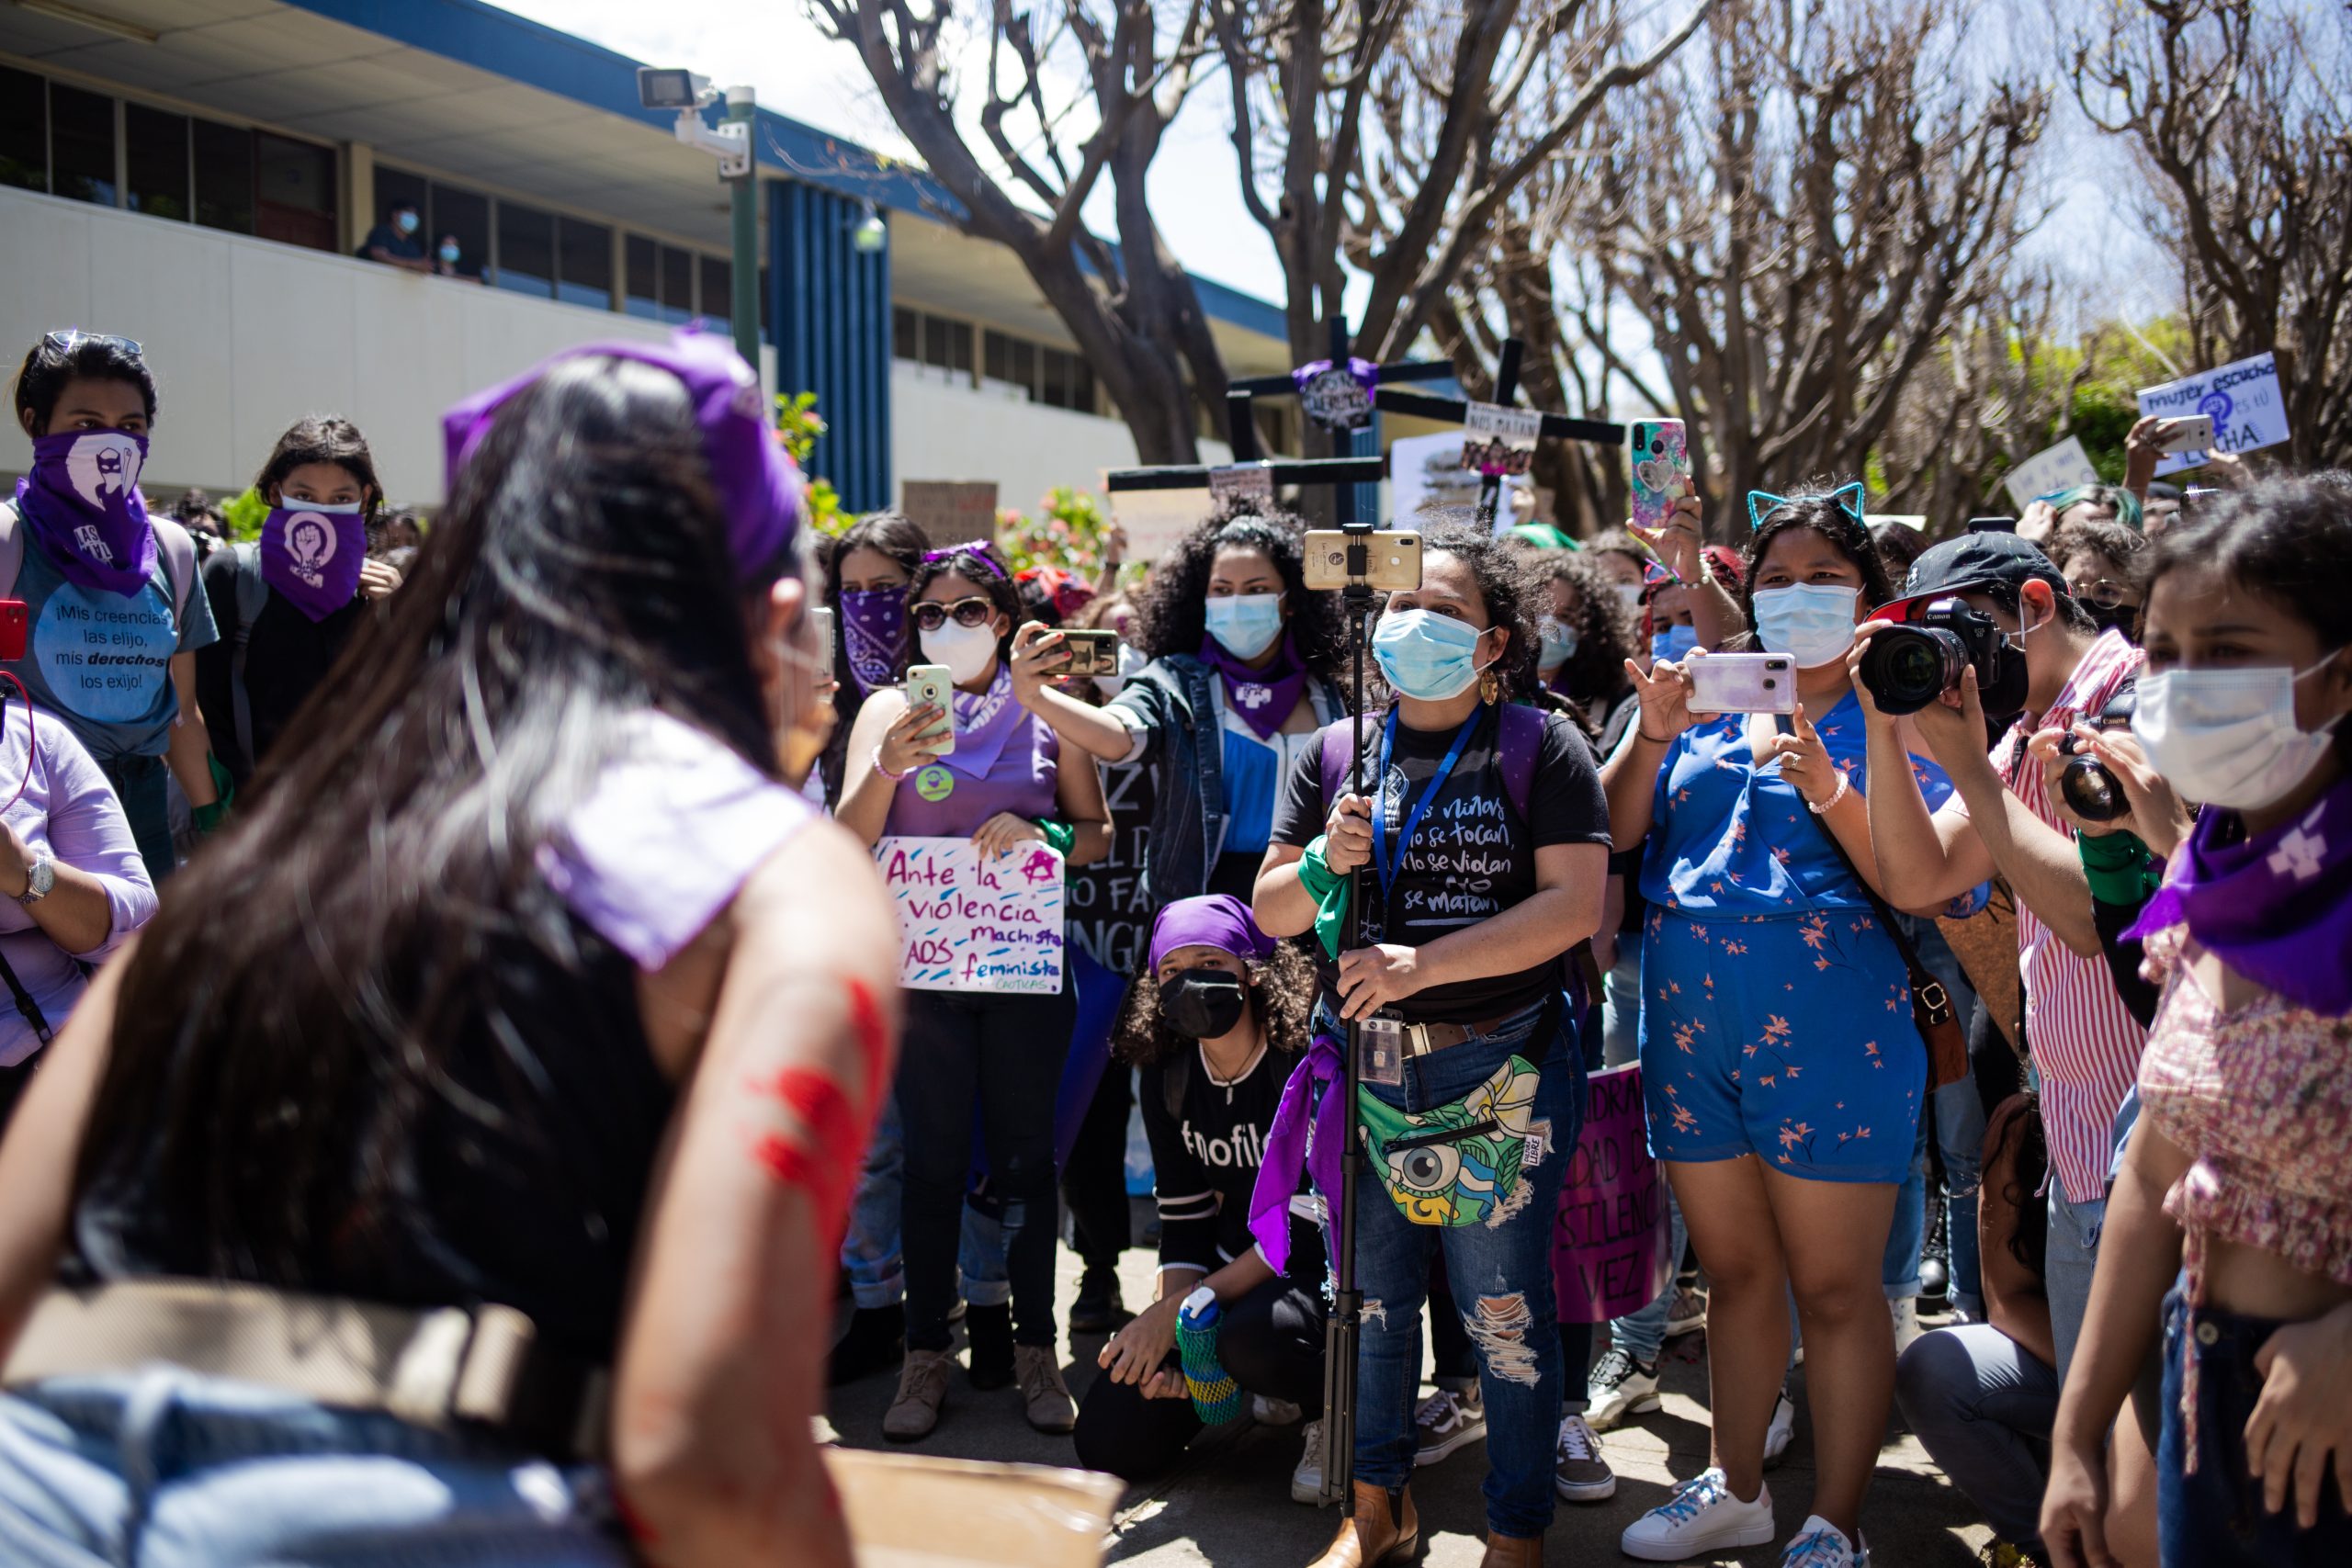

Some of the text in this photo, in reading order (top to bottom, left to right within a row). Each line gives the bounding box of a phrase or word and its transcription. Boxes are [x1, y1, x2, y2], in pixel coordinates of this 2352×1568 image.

[56, 604, 168, 626] ¡Mis creencias
[84, 629, 148, 649] las elijo,
[56, 650, 165, 668] mis derechos
[81, 673, 142, 691] los exijo!
[887, 849, 1001, 890] Ante la
[1452, 850, 1511, 875] violan
[1405, 890, 1424, 910] se
[1530, 1137, 1540, 1164] LIBRE
[1578, 1251, 1641, 1303] VEZ
